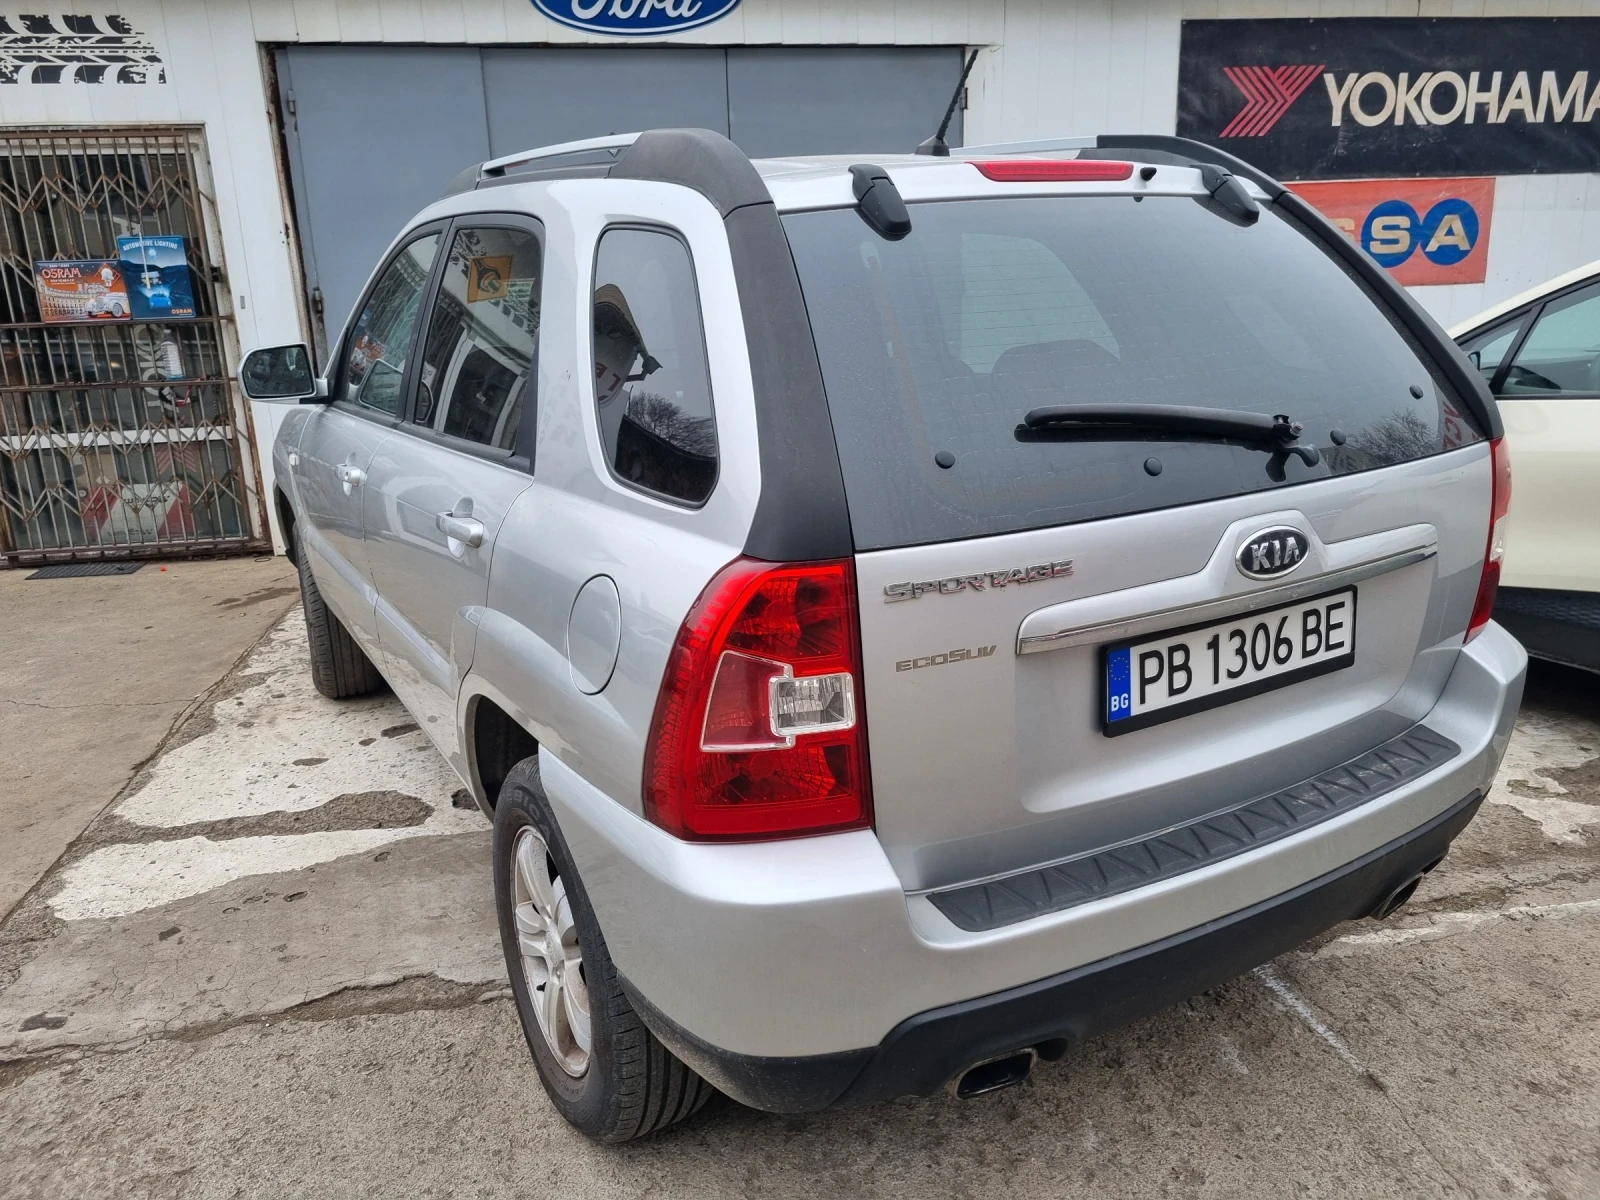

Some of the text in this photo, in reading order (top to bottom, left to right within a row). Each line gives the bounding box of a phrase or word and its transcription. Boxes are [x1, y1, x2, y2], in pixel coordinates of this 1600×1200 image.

[154, 240, 178, 250] LIGHTING
[41, 267, 82, 279] OSRAM
[1250, 536, 1301, 571] KIA
[884, 558, 1075, 604] SPORTAGE
[1139, 600, 1346, 705] PB 1306 BE
[1110, 693, 1129, 712] BG
